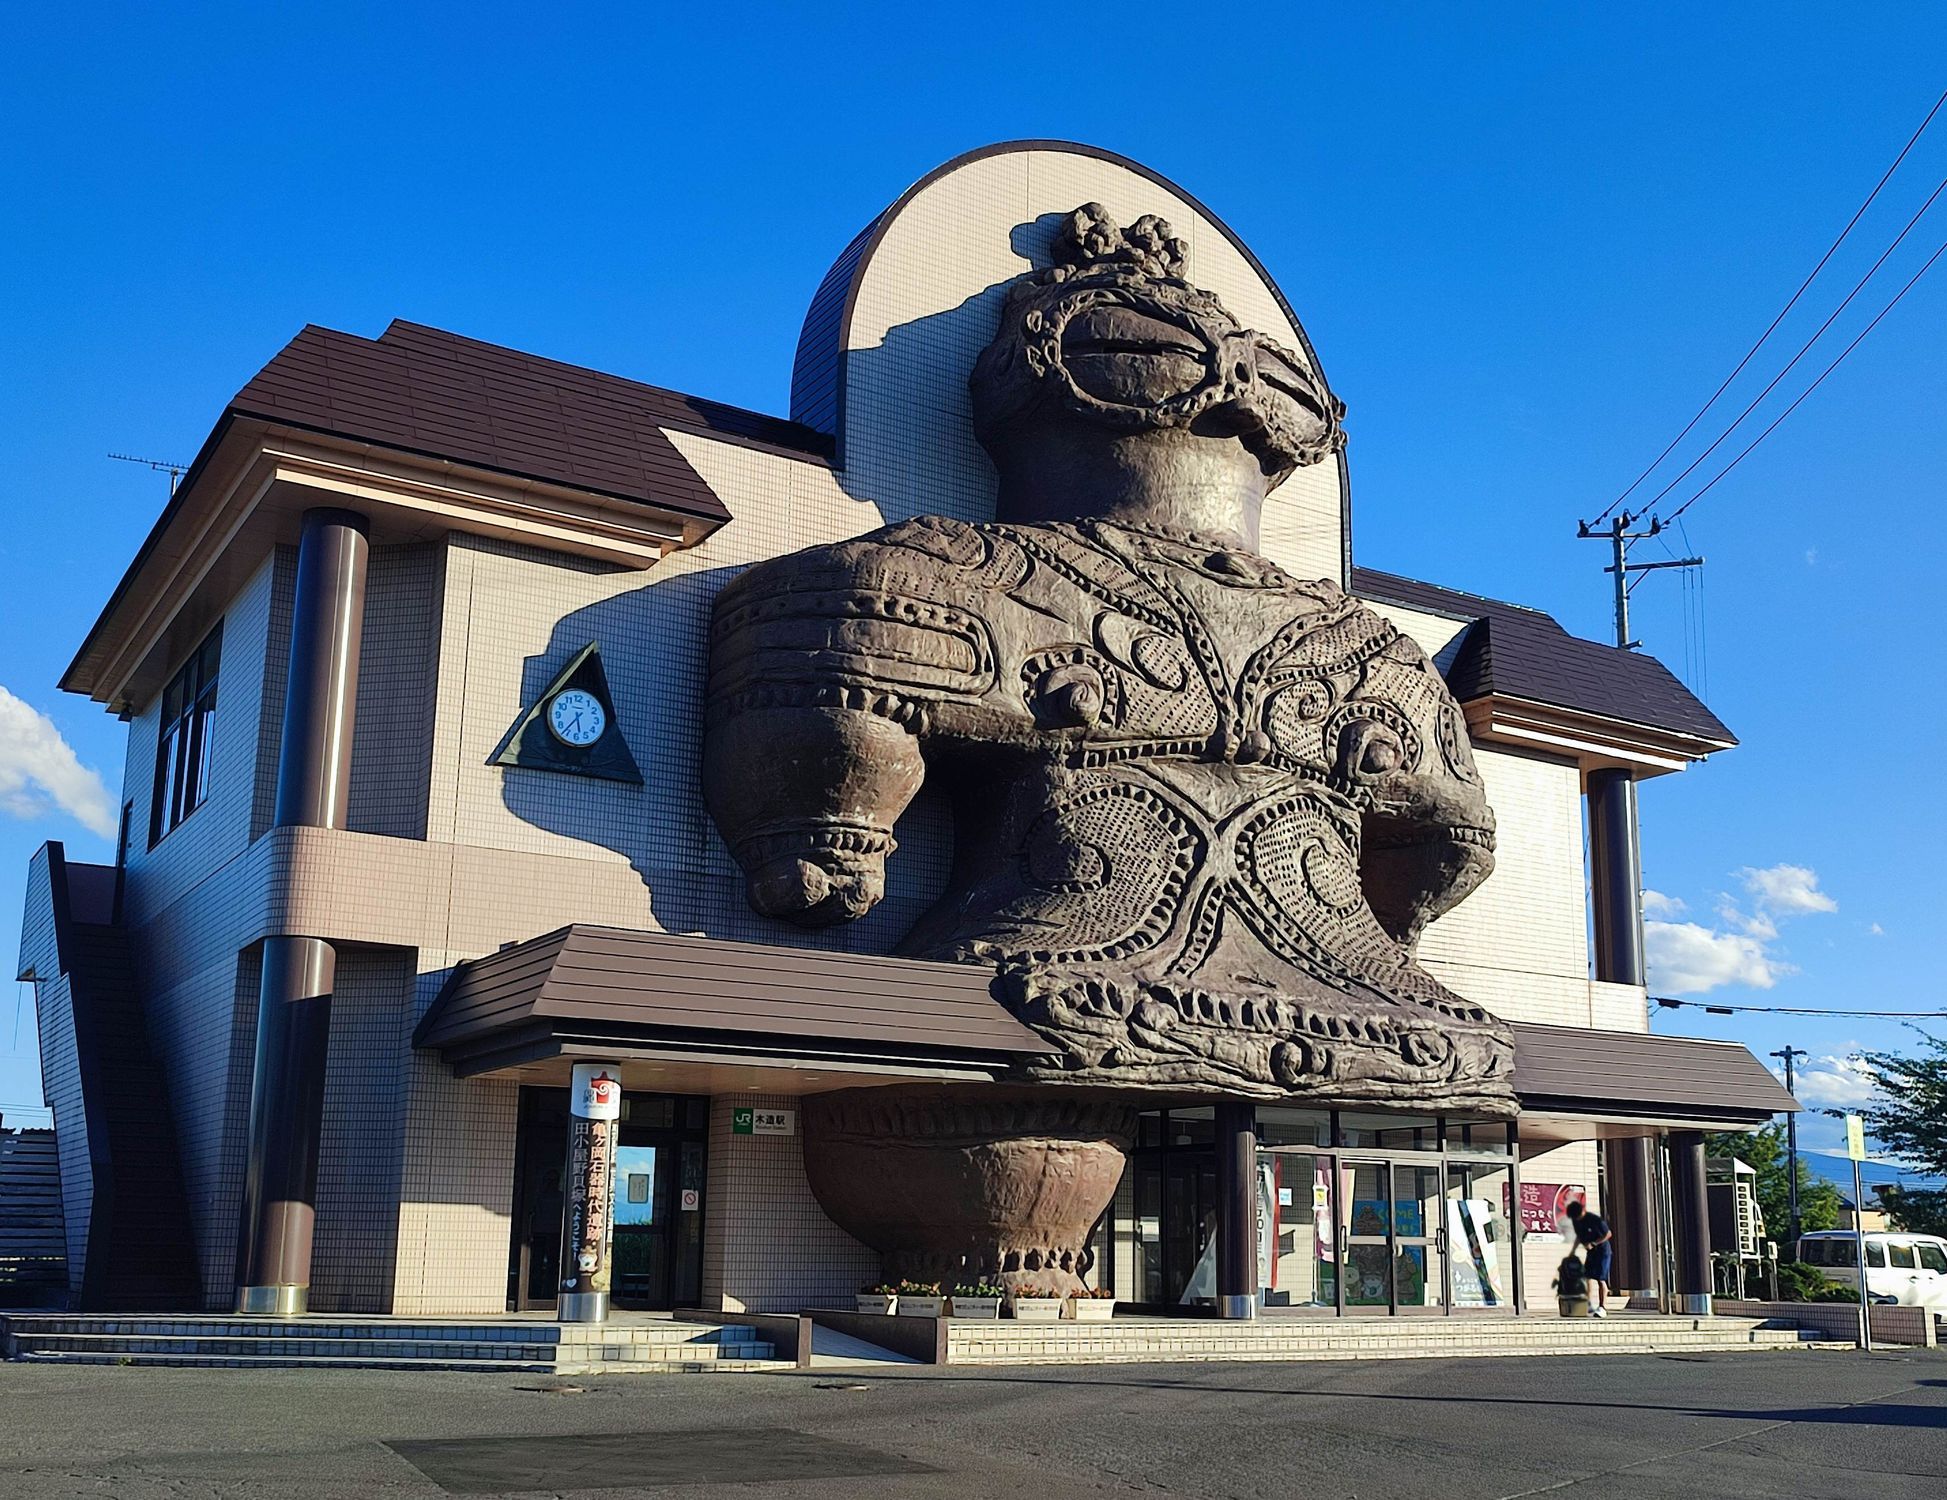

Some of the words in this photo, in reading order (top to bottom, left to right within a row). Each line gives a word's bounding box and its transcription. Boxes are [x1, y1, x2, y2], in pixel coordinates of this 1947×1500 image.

[565, 696, 572, 704] 11
[574, 695, 583, 703] 12
[558, 702, 567, 711] 10
[555, 711, 561, 719] 9
[591, 707, 597, 715] 2
[558, 721, 563, 729] 8
[594, 717, 599, 725] 3
[589, 726, 595, 734] 4
[573, 733, 579, 741] 6
[583, 731, 589, 739] 5
[736, 1113, 751, 1123] JR
[755, 1114, 785, 1125] 木造駅
